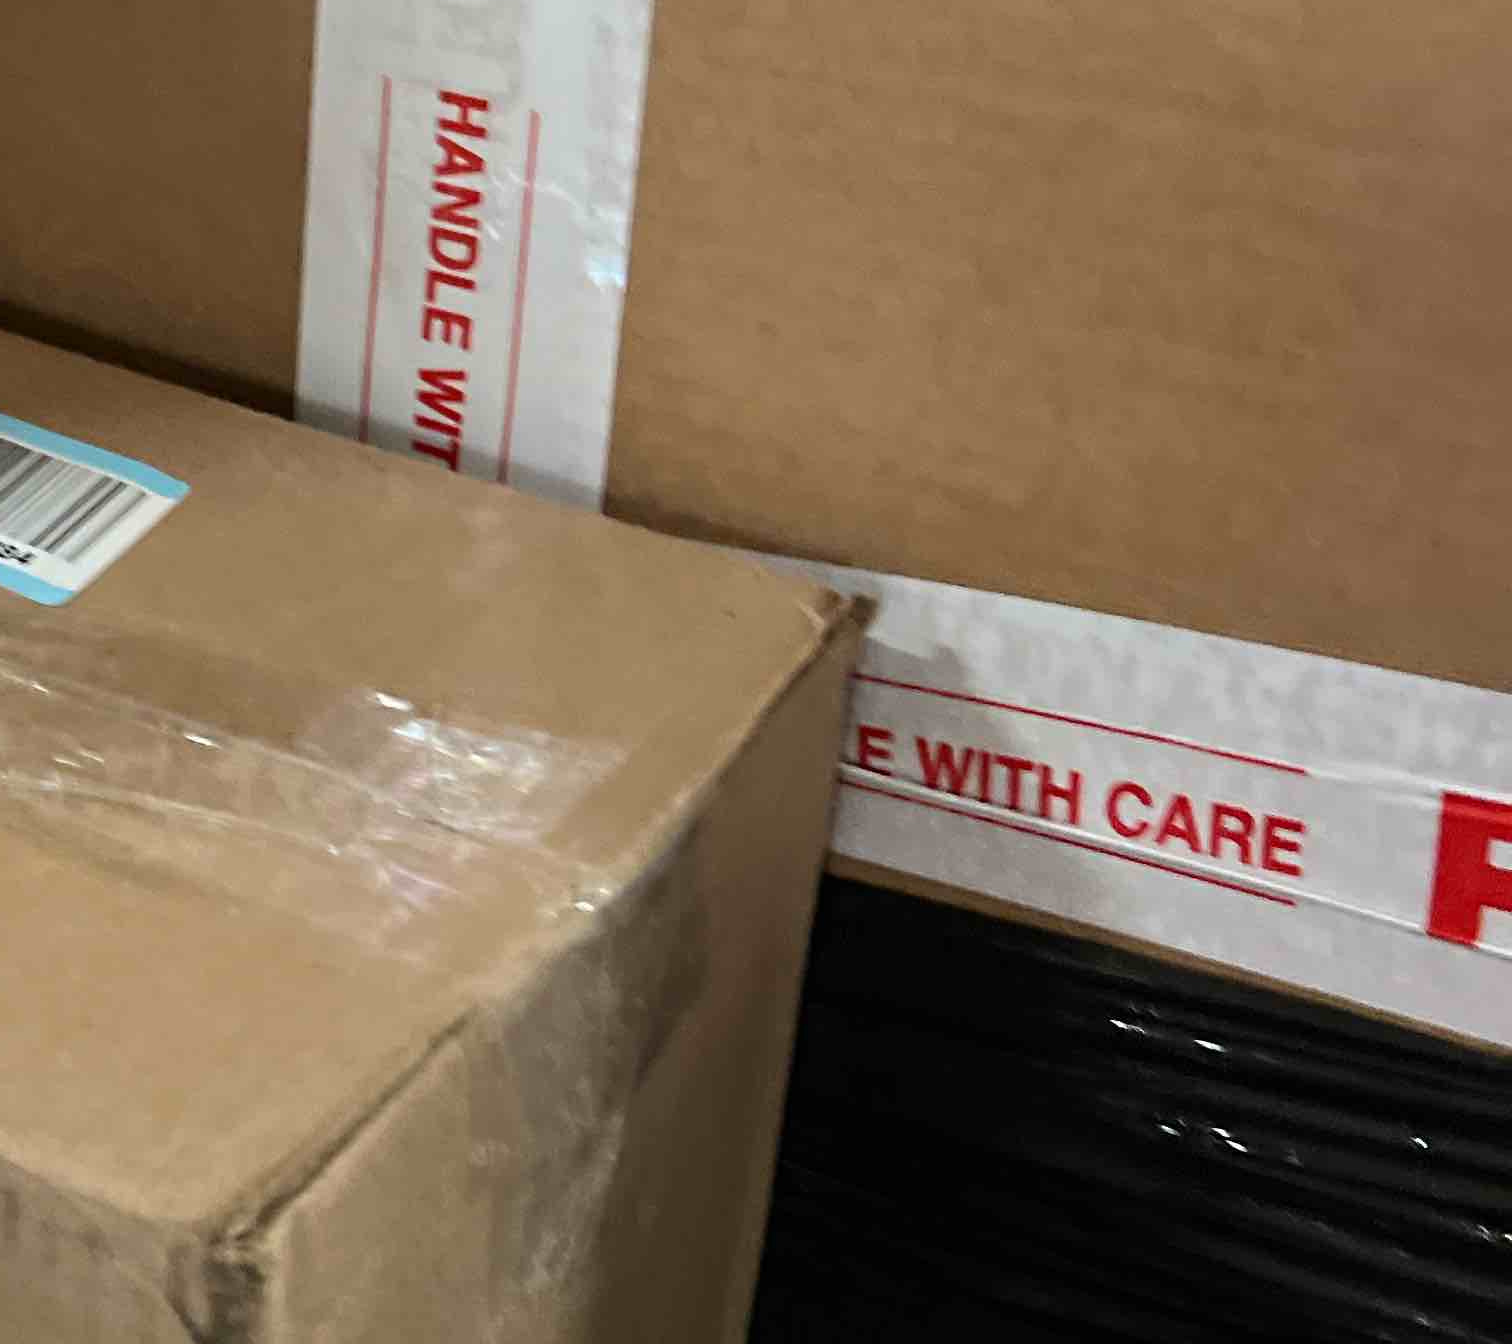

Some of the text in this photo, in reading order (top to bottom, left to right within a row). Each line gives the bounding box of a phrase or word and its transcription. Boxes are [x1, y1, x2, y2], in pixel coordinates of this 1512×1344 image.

[411, 90, 489, 473] HANDLE WIT
[916, 737, 1083, 829] WITH
[1104, 780, 1308, 878] CARE
